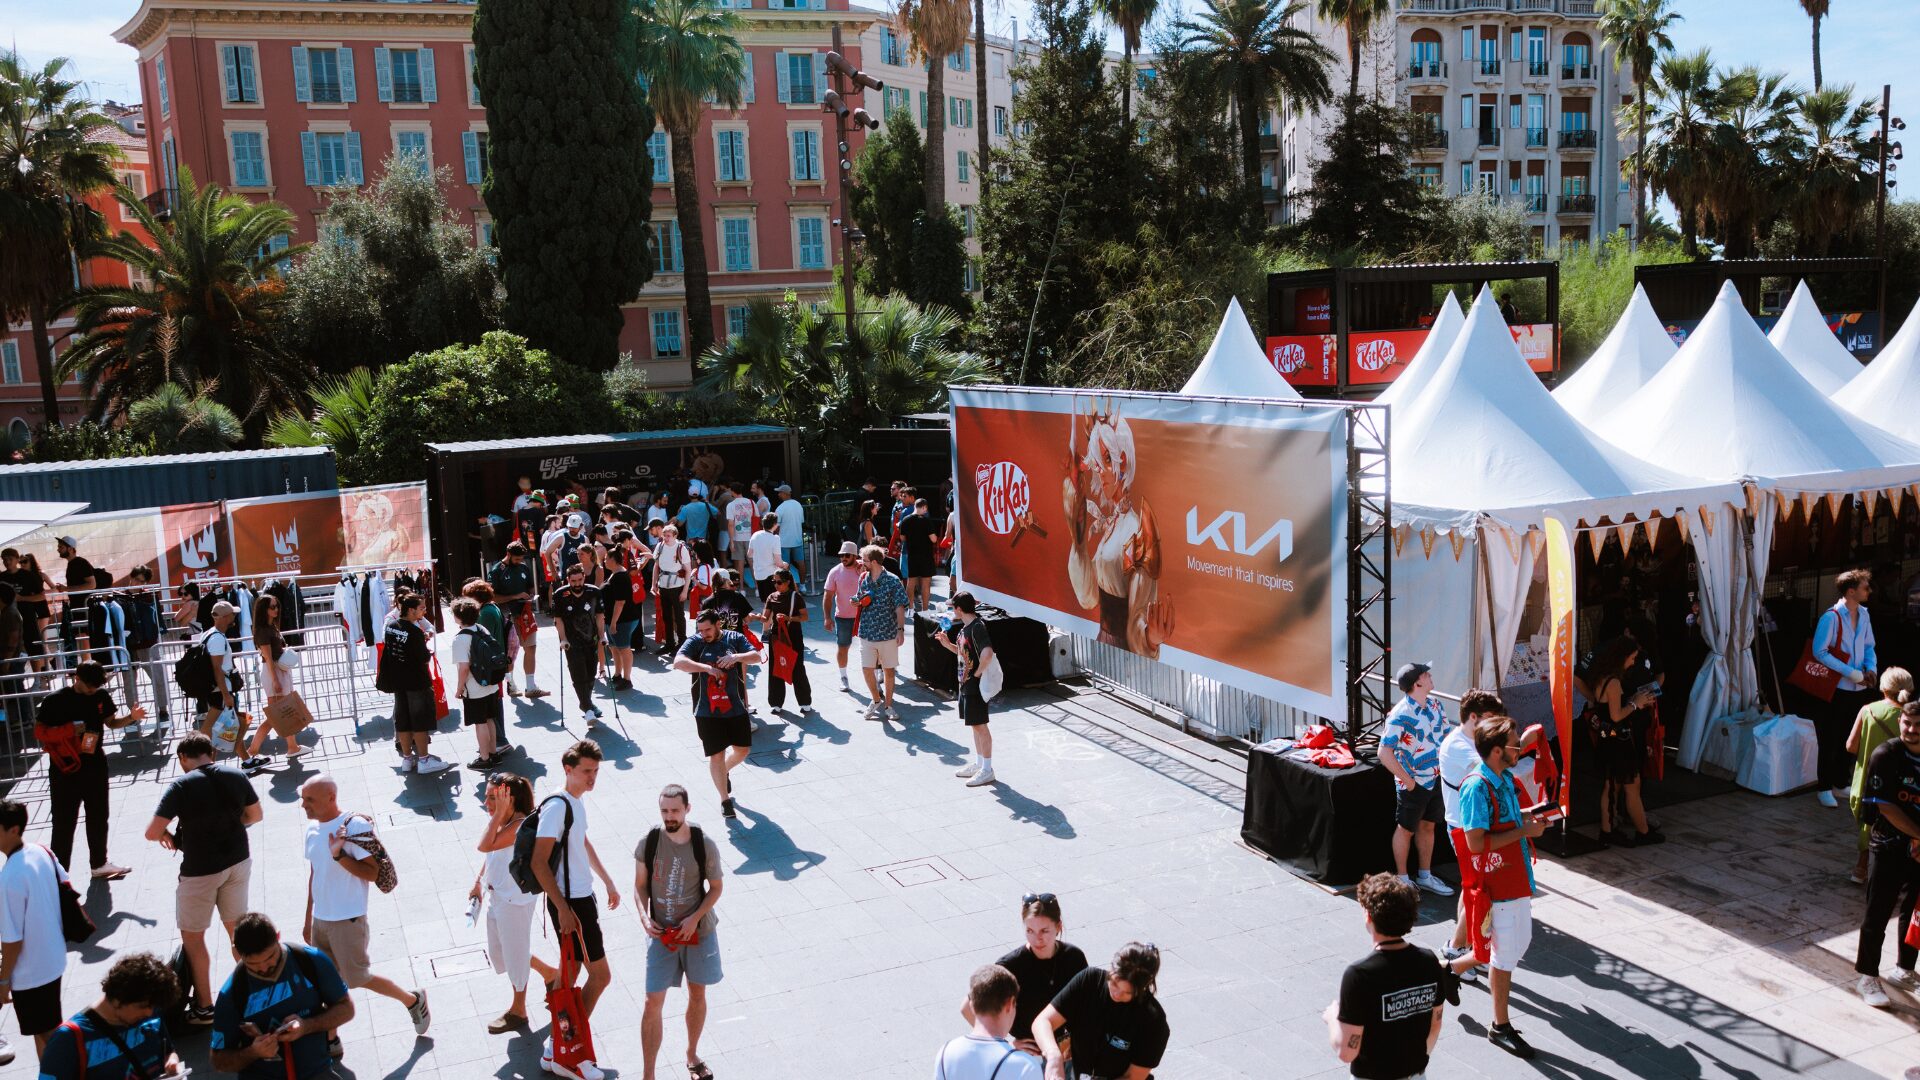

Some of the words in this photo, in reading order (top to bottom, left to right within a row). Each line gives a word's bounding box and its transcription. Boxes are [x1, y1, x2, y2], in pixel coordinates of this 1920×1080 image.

[1277, 344, 1304, 372] KitKat
[1362, 340, 1393, 369] KitKat
[539, 455, 579, 472] LEVEL
[541, 465, 568, 480] UP
[983, 463, 1028, 533] KitKat
[1186, 504, 1294, 564] KIA
[275, 555, 300, 564] LEC
[276, 563, 301, 571] FINALS
[183, 569, 219, 582] LEC
[1187, 555, 1234, 578] Movement
[1235, 565, 1255, 584] that
[1256, 570, 1295, 593] inspires
[665, 856, 681, 897] Ventoux
[1387, 993, 1435, 1012] MOUSTACHE
